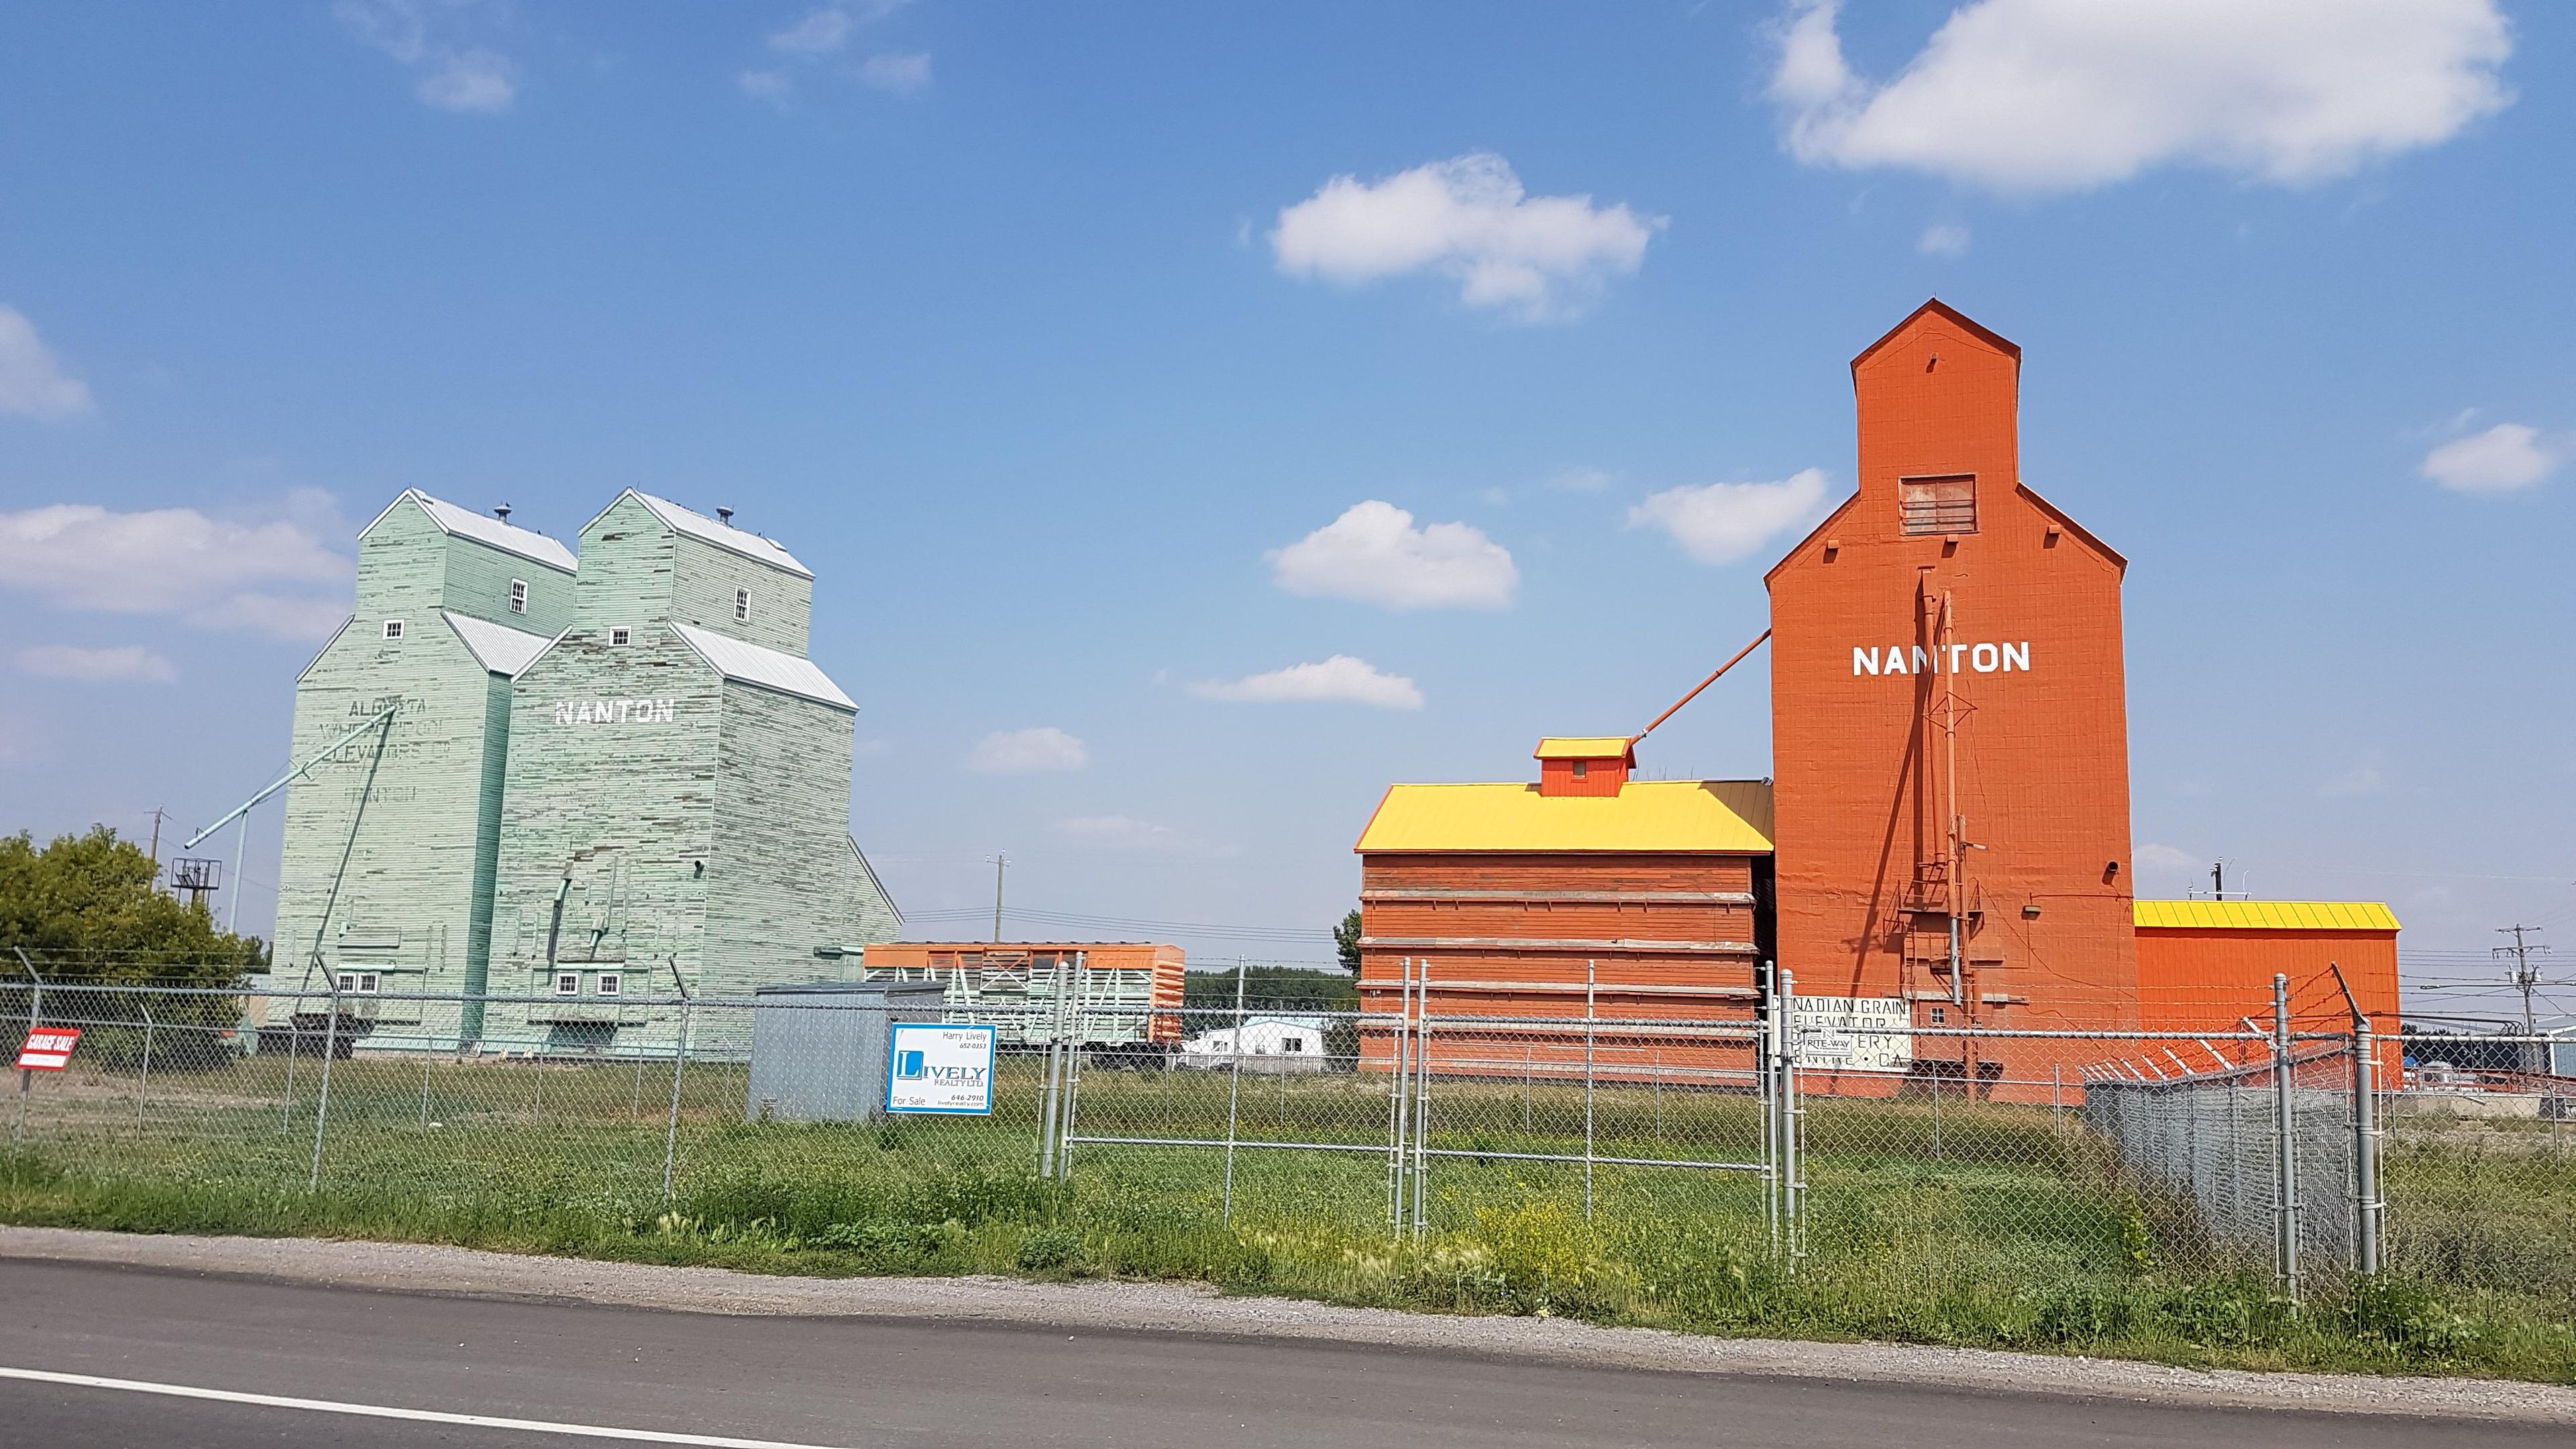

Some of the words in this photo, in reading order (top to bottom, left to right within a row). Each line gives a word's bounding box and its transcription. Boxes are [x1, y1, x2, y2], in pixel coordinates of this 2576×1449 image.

[1853, 641, 2030, 676] NANTON
[555, 698, 674, 724] NANTON
[1772, 997, 1854, 1013] CNADIAN
[1862, 1000, 1906, 1014] GRAIN
[26, 1034, 57, 1051] GARAGE
[54, 1035, 75, 1052] SALE
[943, 1032, 963, 1041] Harry
[966, 1032, 987, 1042] Lively
[1807, 1040, 1850, 1050] RITE-WAY
[893, 1097, 906, 1105] For
[909, 1097, 926, 1106] Sale
